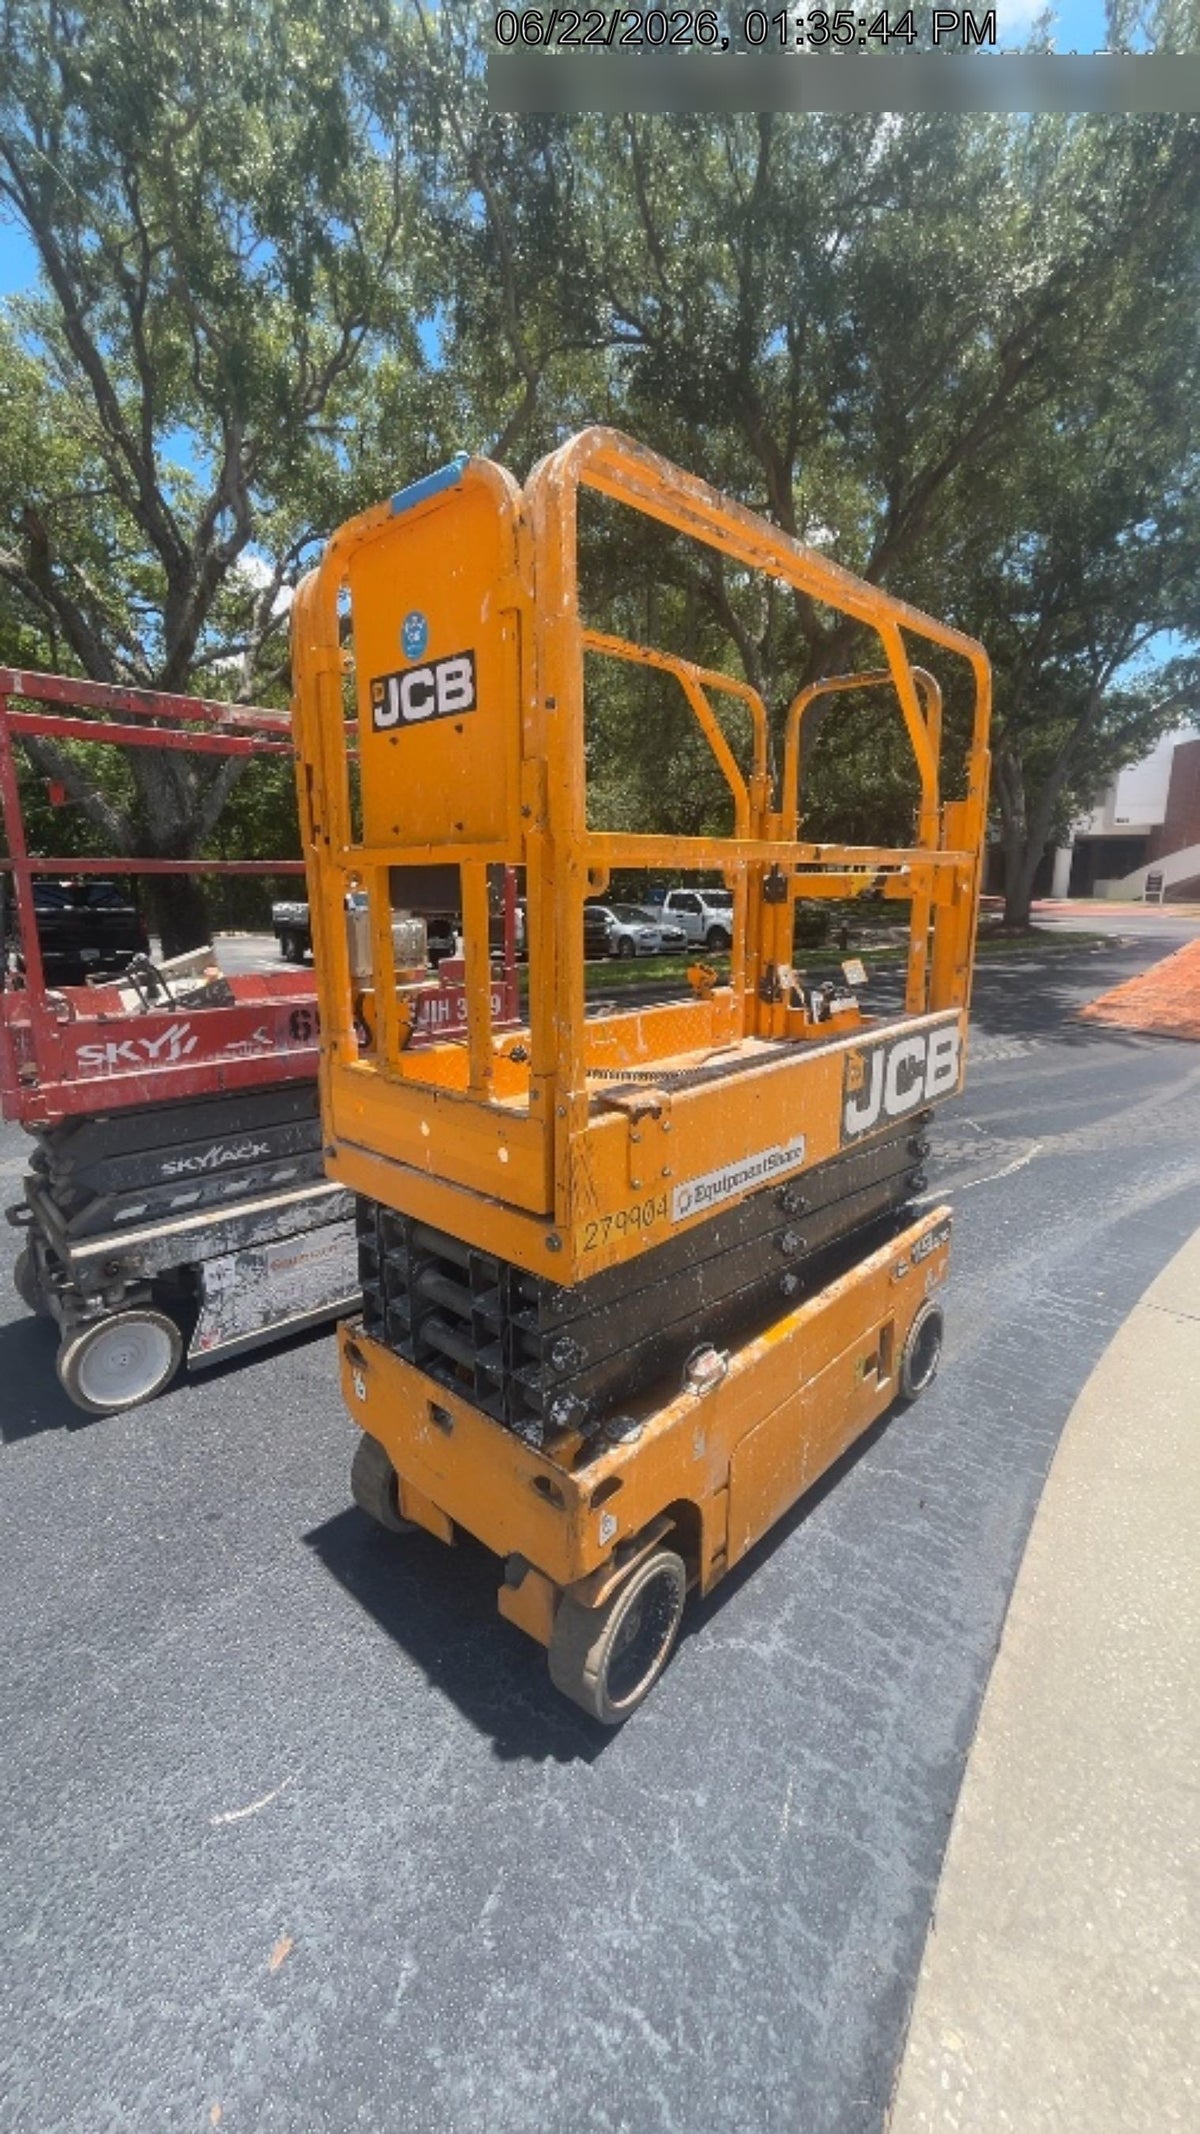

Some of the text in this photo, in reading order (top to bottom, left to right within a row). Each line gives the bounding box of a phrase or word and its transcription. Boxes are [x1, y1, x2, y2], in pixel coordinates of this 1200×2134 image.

[373, 657, 475, 727] JCB
[457, 994, 501, 1020] 39
[845, 1026, 960, 1134] JCB
[160, 1141, 272, 1175] SKYJACK
[583, 1191, 668, 1251] 279904
